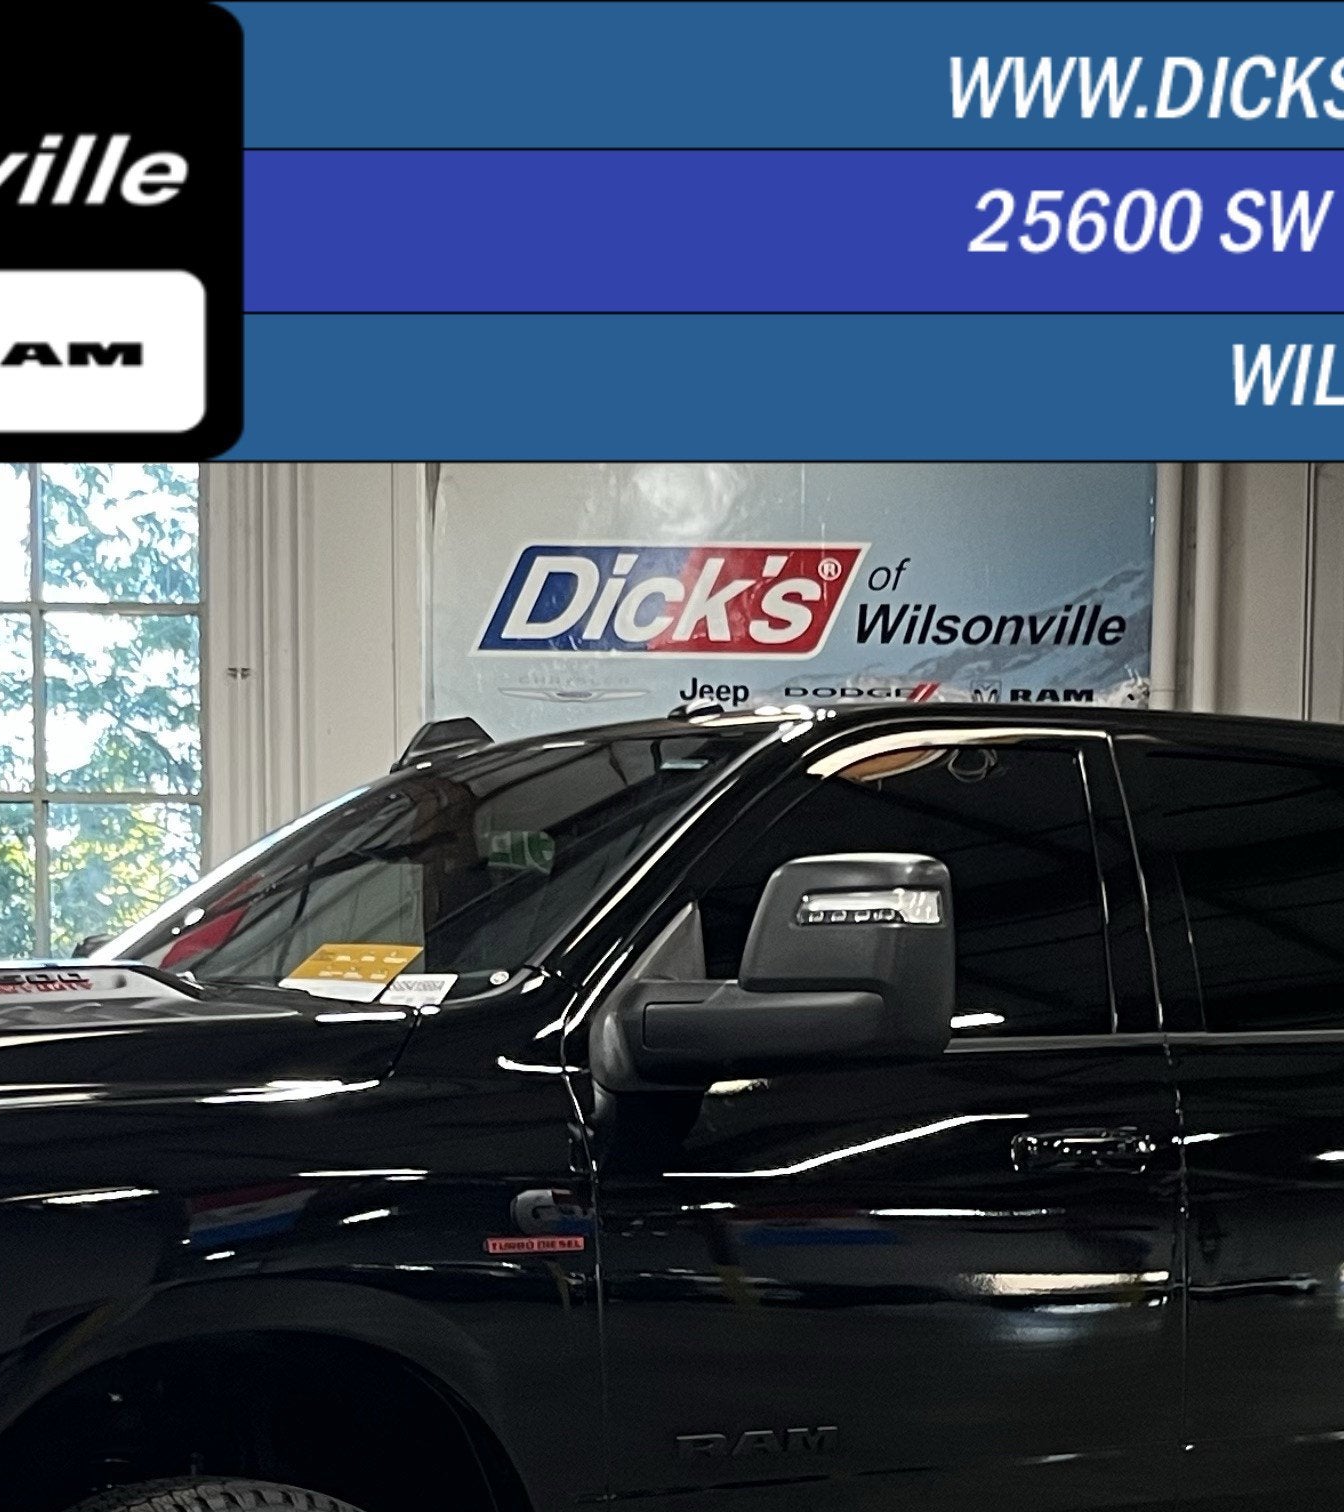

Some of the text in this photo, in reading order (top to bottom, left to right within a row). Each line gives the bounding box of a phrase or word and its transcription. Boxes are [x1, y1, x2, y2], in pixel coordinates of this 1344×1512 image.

[868, 557, 911, 591] of
[501, 553, 821, 644] Dick's
[856, 603, 1127, 645] Wilsonville
[679, 677, 750, 707] Jeep
[1010, 689, 1094, 702] RAM
[676, 1426, 839, 1460] RAM
